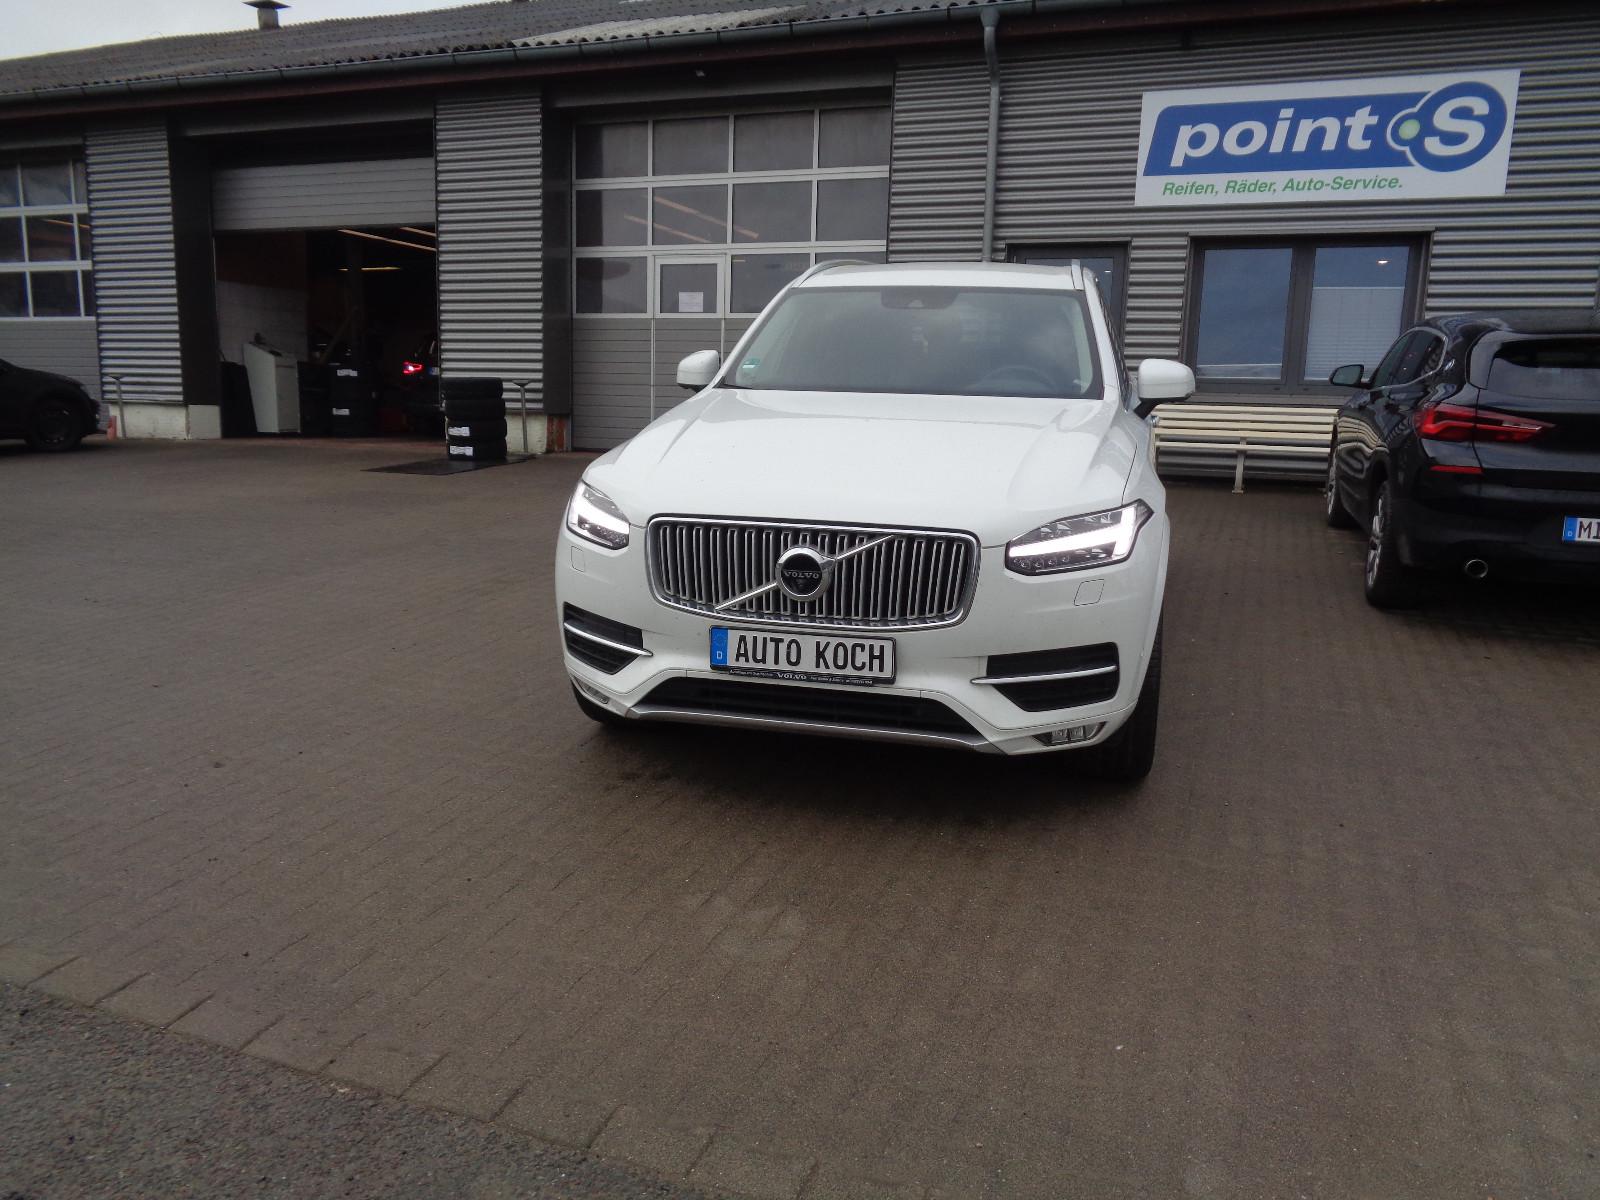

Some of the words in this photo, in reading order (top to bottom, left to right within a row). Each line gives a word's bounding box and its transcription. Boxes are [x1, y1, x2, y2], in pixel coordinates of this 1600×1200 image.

[1170, 104, 1380, 168] point
[1423, 95, 1490, 157] S
[1162, 181, 1219, 197] Reifen,
[1224, 178, 1278, 195] Räder,
[1282, 174, 1404, 192] Auto-Service.
[784, 570, 820, 580] VOLVO
[735, 634, 802, 667] AUTO
[815, 640, 885, 673] KOCH
[776, 672, 807, 681] VOLVO
